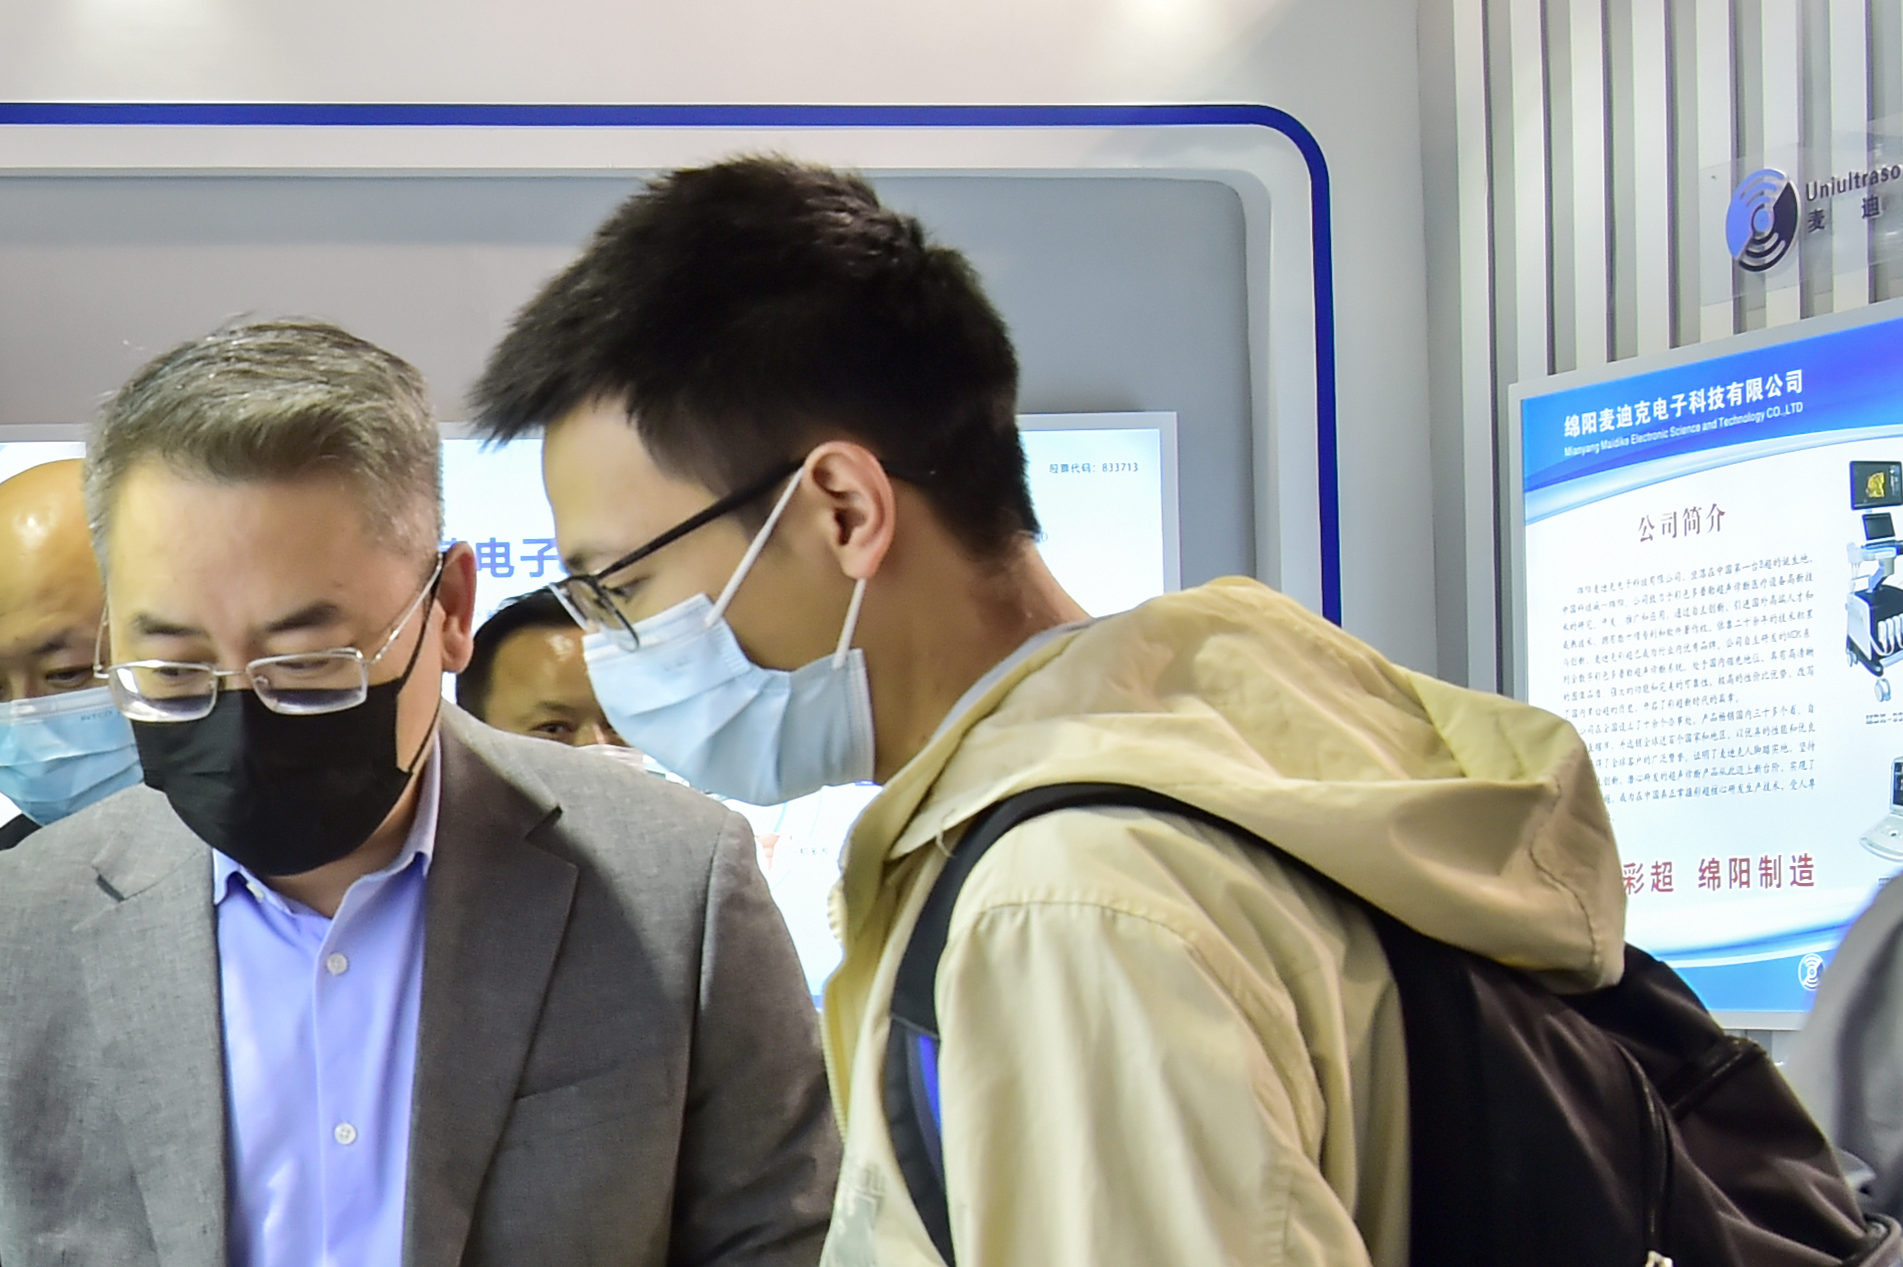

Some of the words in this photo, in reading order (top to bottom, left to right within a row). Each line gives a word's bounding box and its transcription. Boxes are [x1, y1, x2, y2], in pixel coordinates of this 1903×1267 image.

[1564, 369, 1803, 438] 绵阳麦迪克电子科技有限公司
[1638, 502, 1726, 543] 公司简介
[1699, 853, 1815, 891] 绵阳制造
